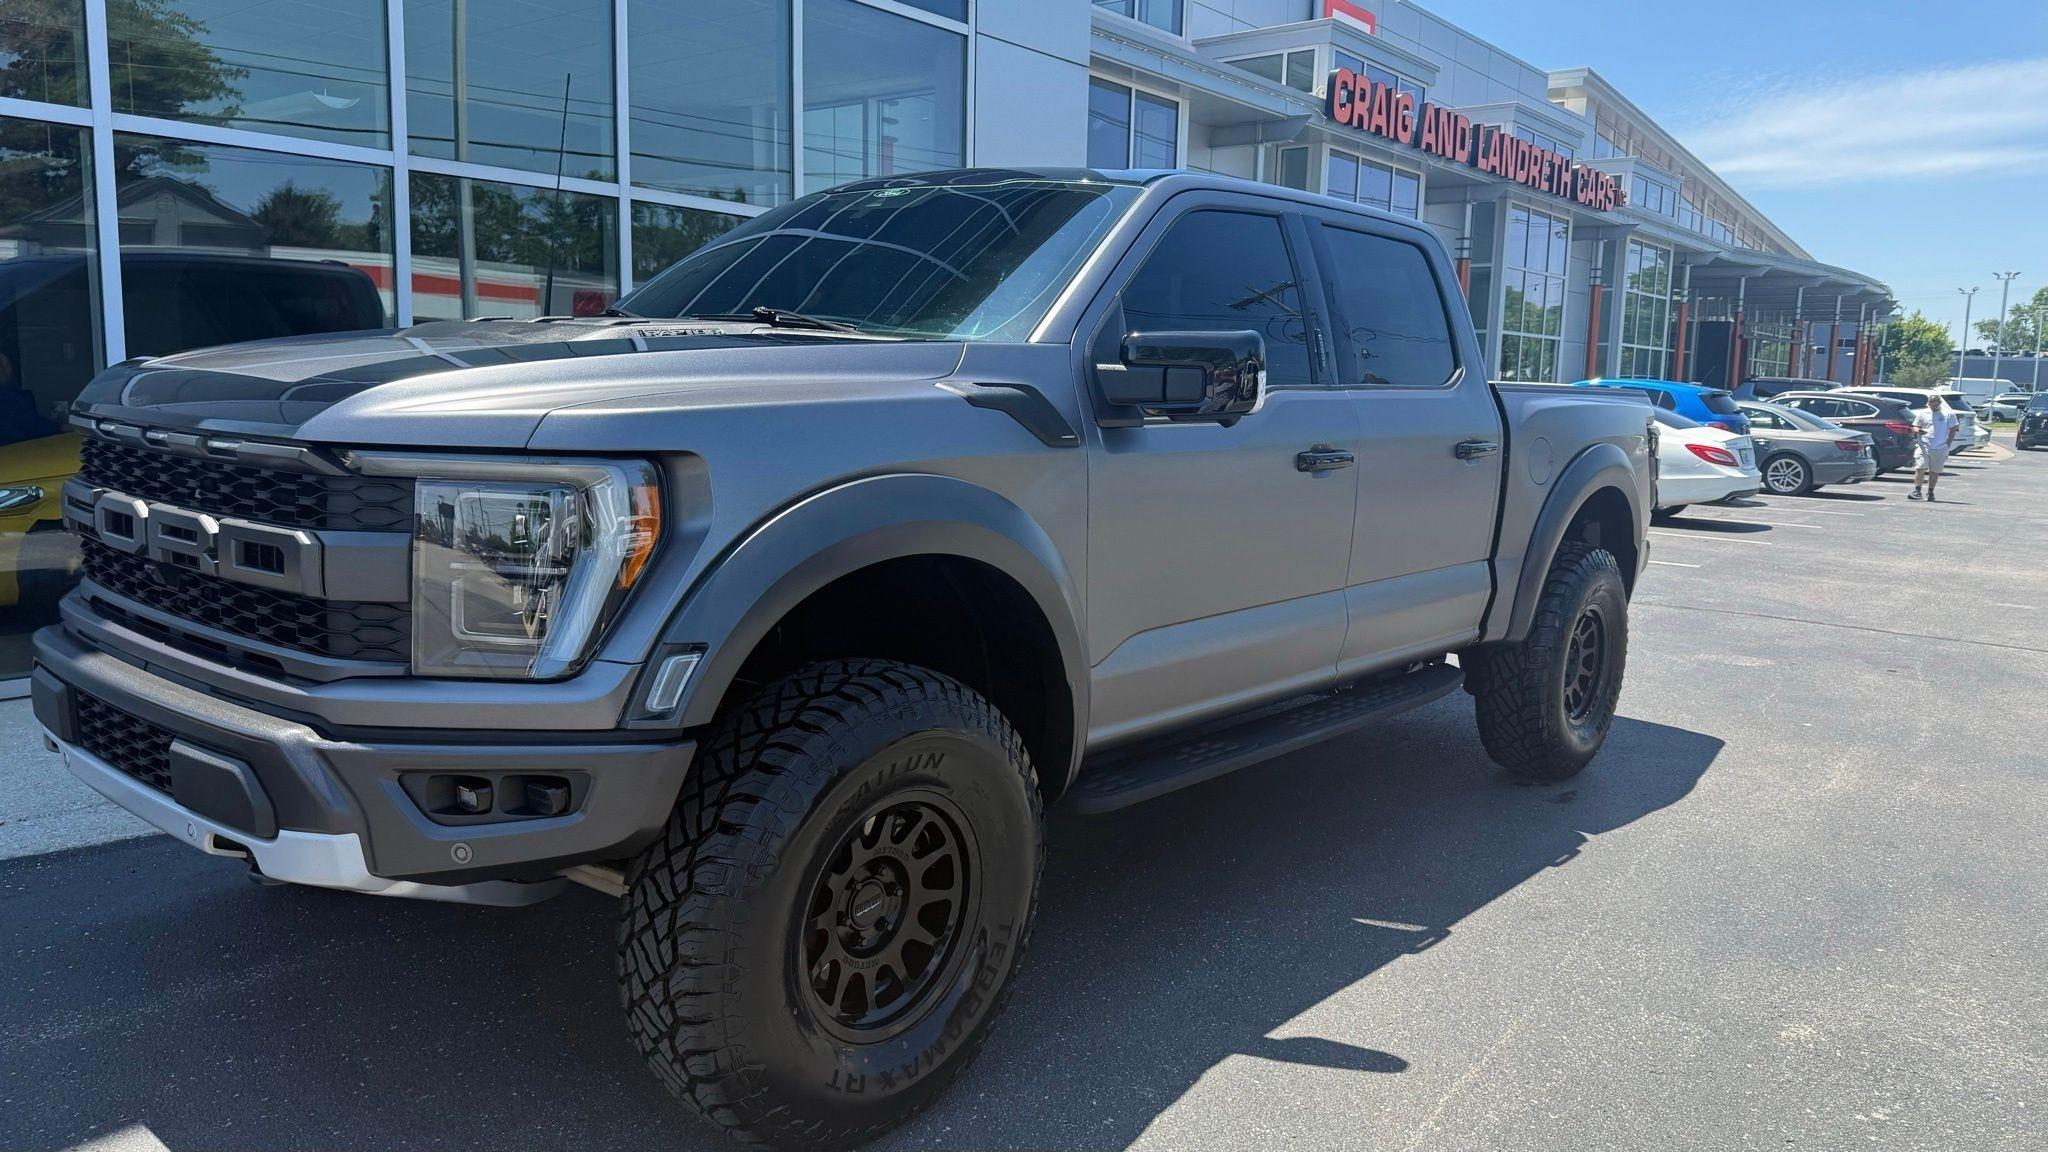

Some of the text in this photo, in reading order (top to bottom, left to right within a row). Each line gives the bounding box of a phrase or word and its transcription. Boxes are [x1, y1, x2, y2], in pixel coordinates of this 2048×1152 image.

[1333, 67, 1414, 144] CRAIG
[1420, 102, 1471, 163] AND
[1477, 123, 1573, 199] LANDRETH
[1576, 164, 1615, 212] CARS
[62, 479, 323, 597] FORD
